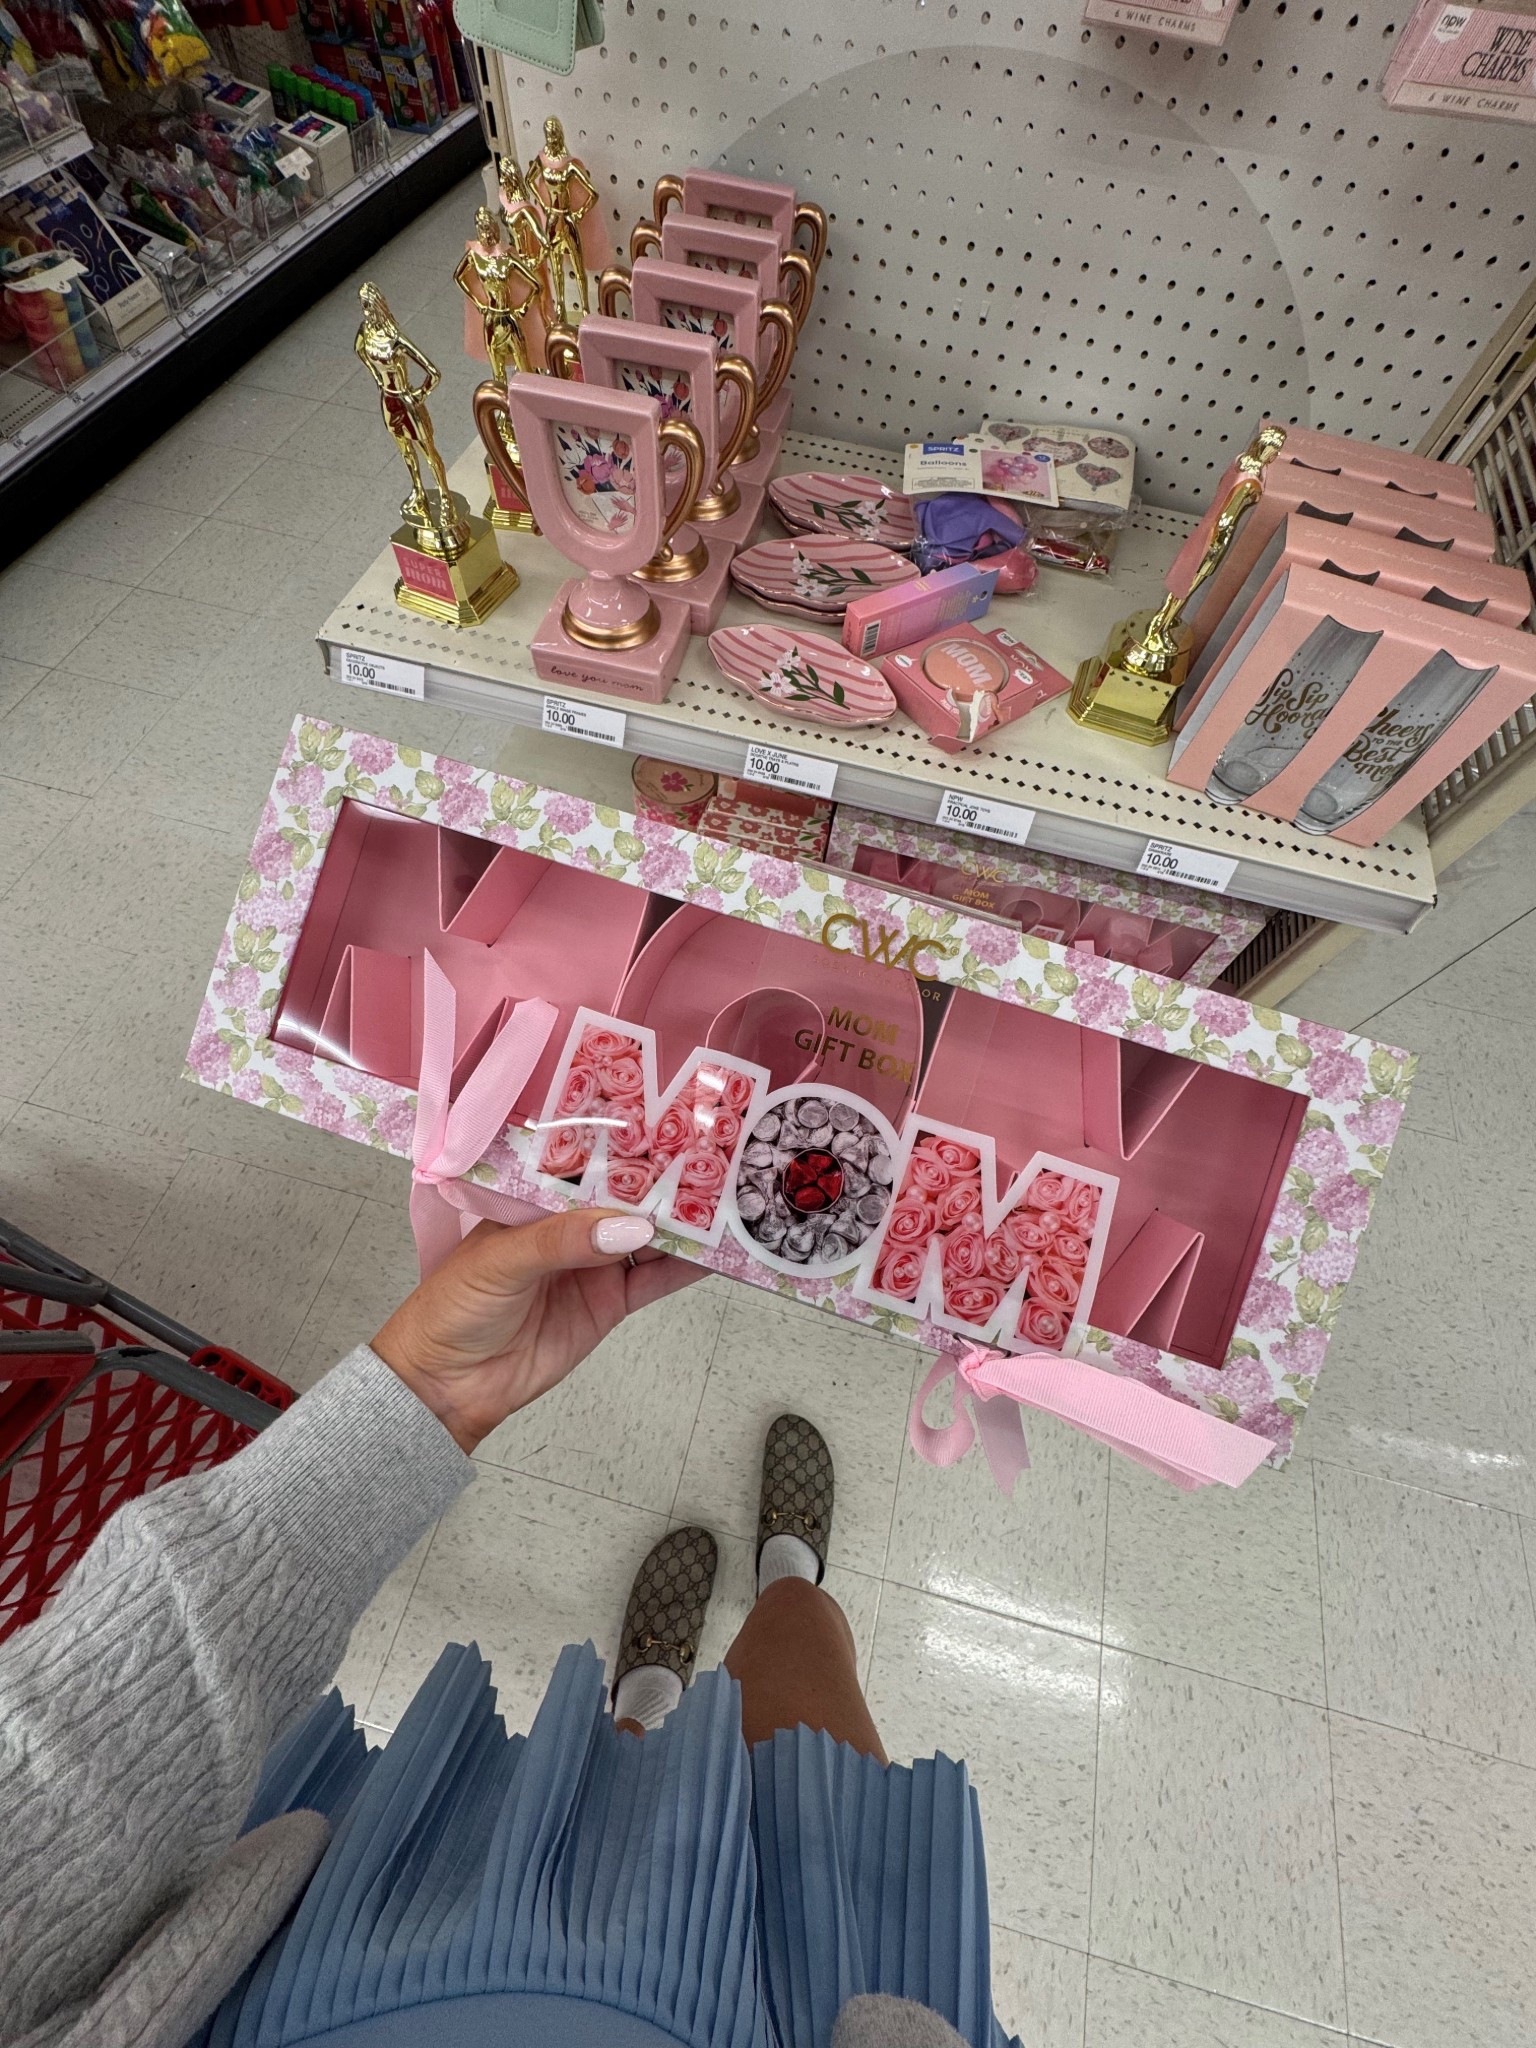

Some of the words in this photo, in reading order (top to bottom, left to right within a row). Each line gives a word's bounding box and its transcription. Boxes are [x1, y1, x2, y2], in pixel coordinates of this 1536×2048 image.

[1126, 10, 1152, 24] WINE
[1158, 16, 1196, 32] CHARMS
[1441, 14, 1467, 28] npw
[1489, 25, 1536, 56] WINE
[1461, 51, 1533, 83] CHARMS
[1442, 94, 1471, 107] WINE
[1477, 98, 1520, 112] CHARMS
[402, 556, 443, 577] SUPER
[345, 652, 366, 662] SPRITZ
[941, 643, 993, 685] MOM
[347, 663, 376, 679] 10.00
[551, 665, 578, 678] love
[582, 673, 608, 683] you
[612, 680, 644, 691] mom
[1255, 668, 1294, 707] Sip
[1286, 681, 1330, 711] Sip
[546, 698, 567, 708] SPRITZ
[546, 709, 576, 726] 10.00
[1343, 733, 1405, 763] Best
[1372, 737, 1385, 745] TO
[751, 746, 767, 756] LOVE
[772, 752, 788, 761] JUNE
[750, 757, 780, 774] 10.00
[949, 793, 964, 802] NPW
[946, 804, 978, 821] 10.00
[1150, 842, 1173, 852] SPRITZ
[1146, 852, 1179, 870] 10.00
[961, 861, 1008, 883] CWC
[952, 894, 975, 904] GIFT
[974, 898, 996, 909] BOX
[963, 888, 990, 900] MOM
[827, 1006, 899, 1045] MOM
[794, 1029, 855, 1063] GIFT
[857, 1047, 915, 1084] BOX
[521, 1006, 1121, 1356] MOM
